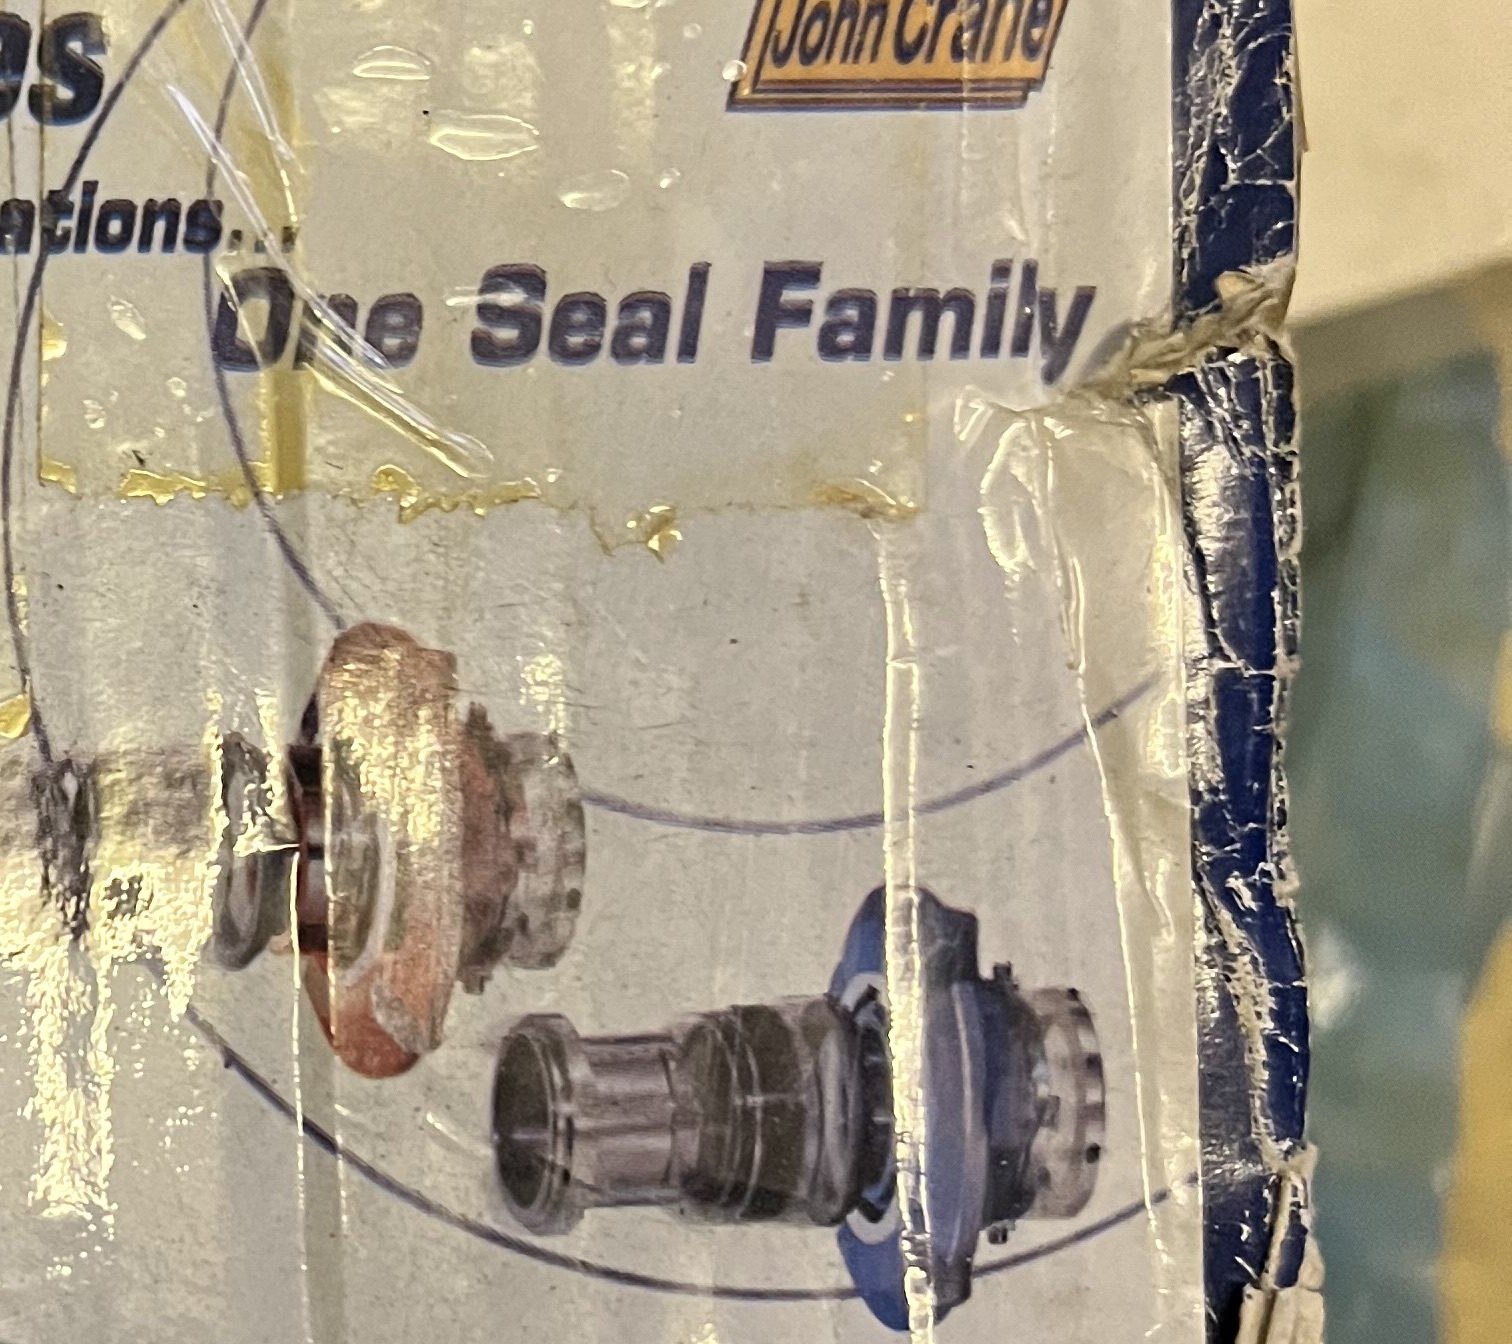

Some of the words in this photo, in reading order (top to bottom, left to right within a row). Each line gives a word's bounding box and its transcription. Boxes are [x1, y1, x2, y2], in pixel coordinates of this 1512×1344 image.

[213, 265, 424, 372] One
[468, 260, 712, 370] Seal
[750, 260, 1097, 385] Family
